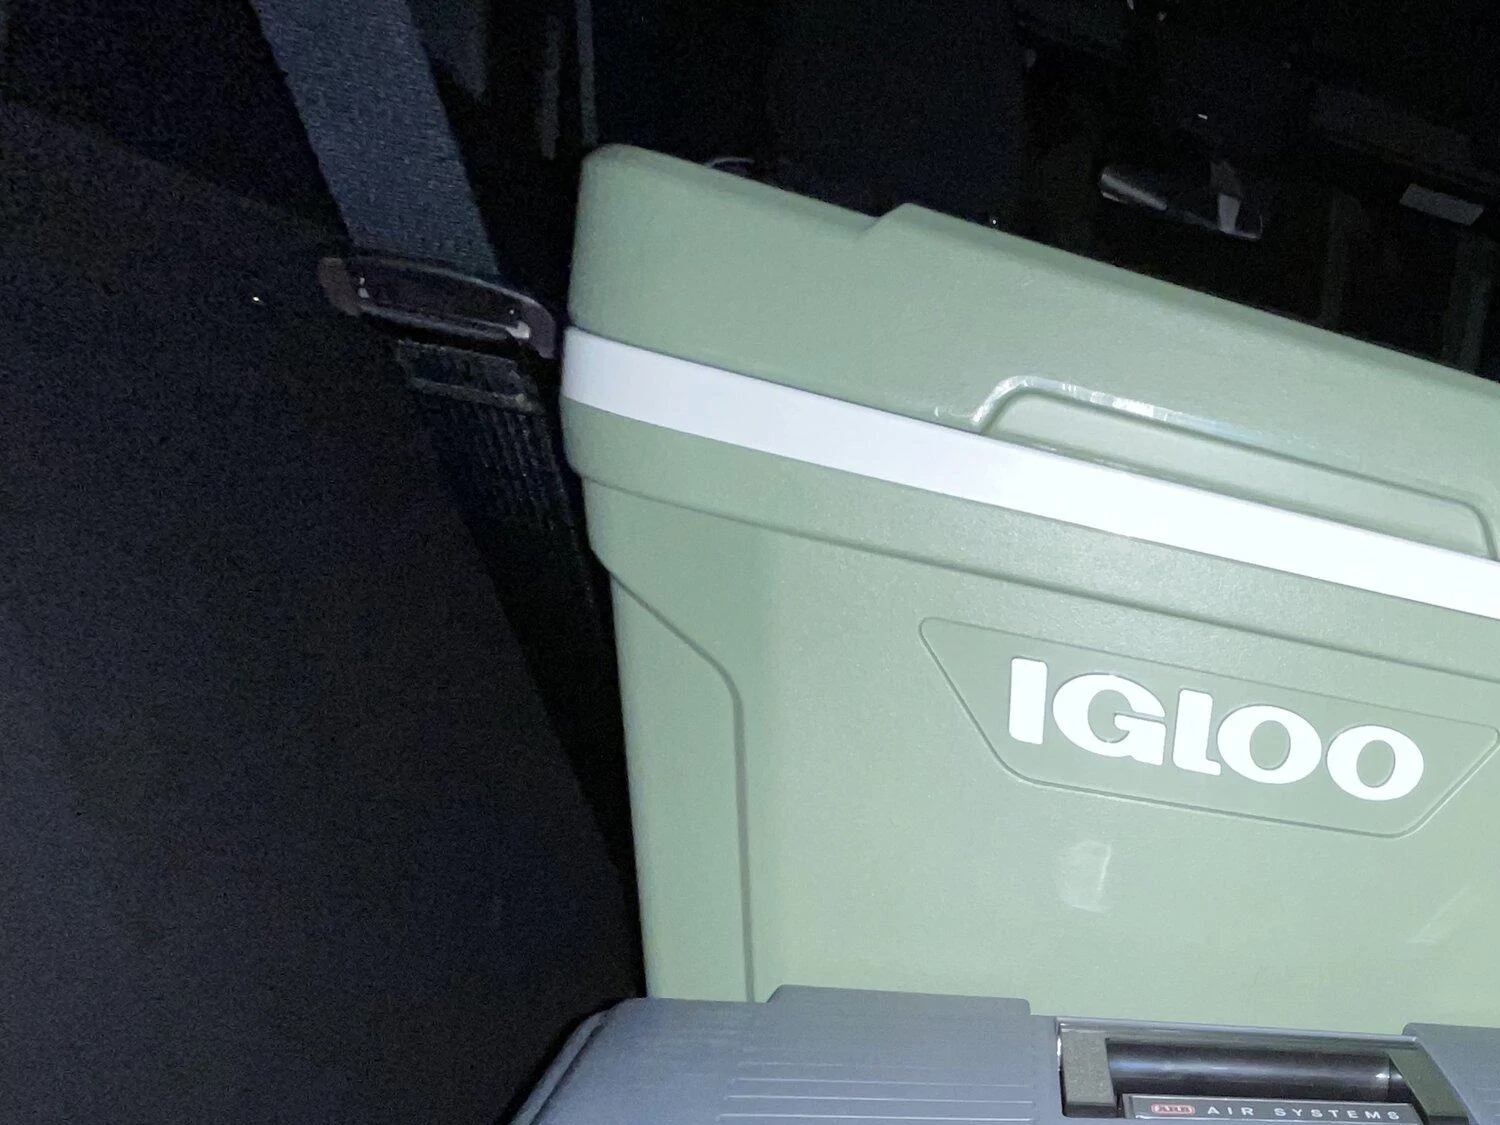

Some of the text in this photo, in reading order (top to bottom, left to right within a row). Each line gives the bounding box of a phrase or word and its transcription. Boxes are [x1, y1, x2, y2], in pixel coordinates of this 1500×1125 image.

[1008, 656, 1424, 801] IGLOO
[1207, 1106, 1254, 1116] AIR
[1274, 1107, 1400, 1121] SYSTEMS
